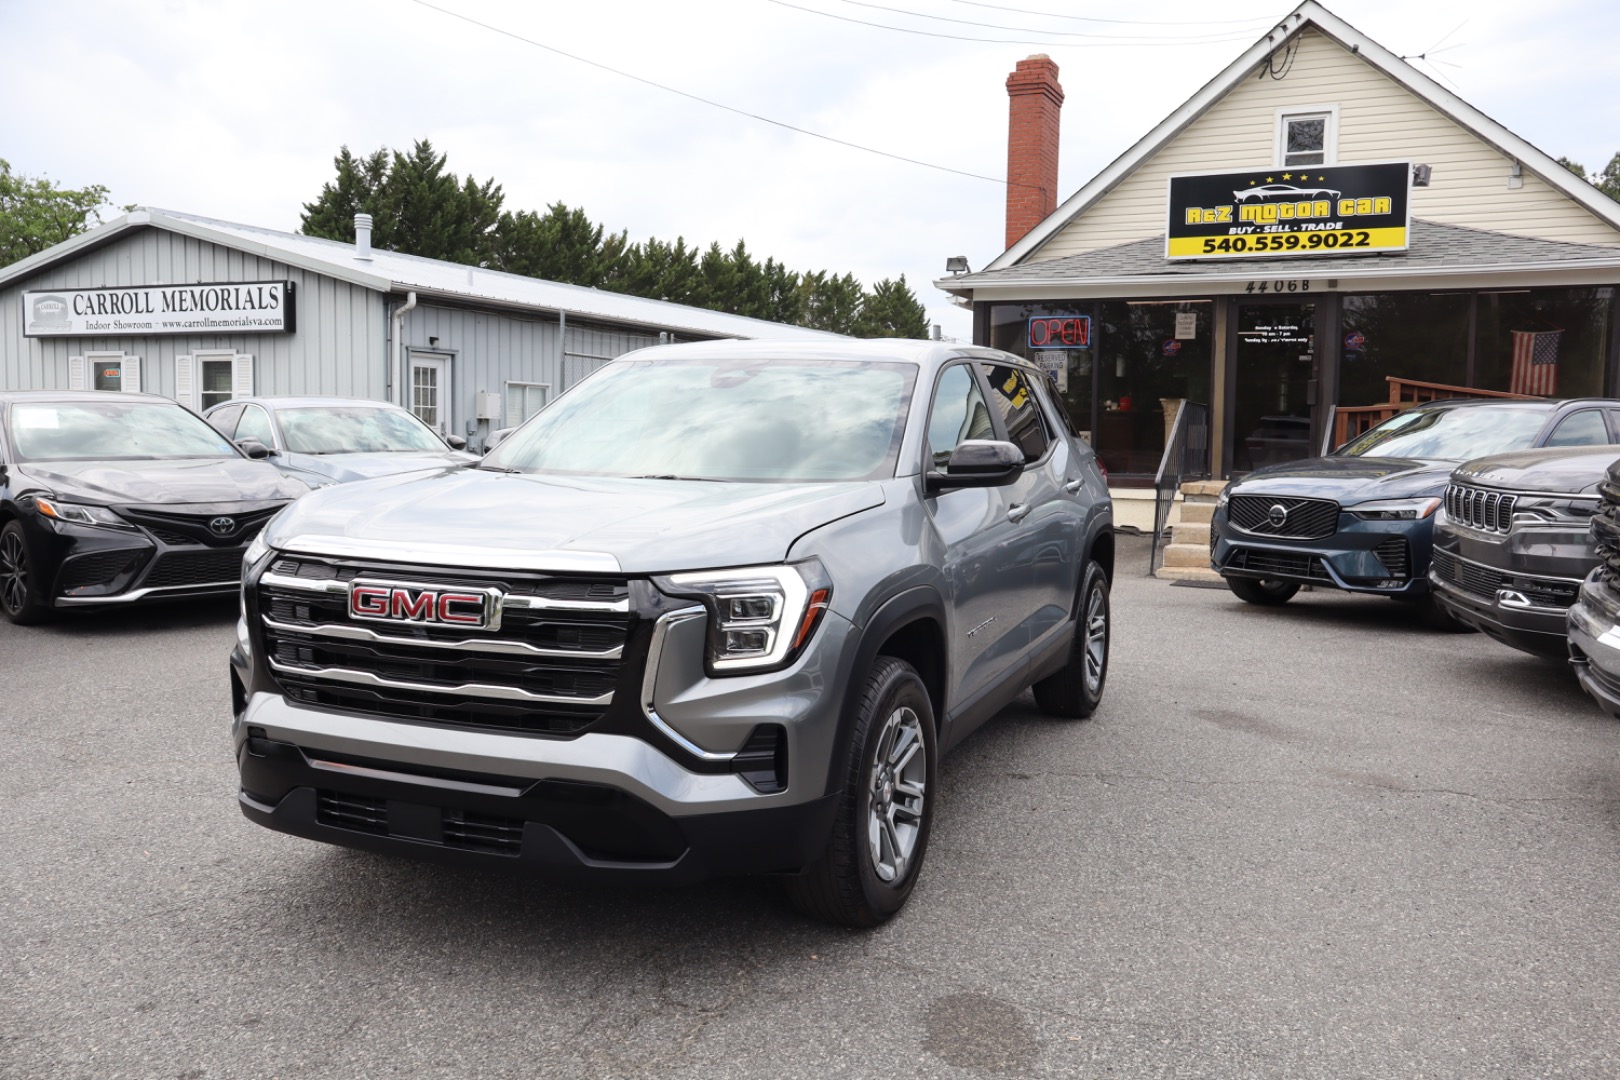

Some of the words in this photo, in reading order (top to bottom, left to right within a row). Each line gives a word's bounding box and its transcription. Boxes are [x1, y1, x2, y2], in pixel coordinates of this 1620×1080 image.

[1229, 226, 1255, 234] BUY
[1263, 225, 1291, 233] SELL
[1301, 222, 1343, 231] TRADE
[1203, 232, 1370, 253] 540.559.9022
[73, 292, 154, 315] CARROLL
[161, 286, 279, 312] MEMORIALS
[86, 320, 111, 330] Indoor
[113, 319, 152, 329] Showroom
[162, 316, 282, 328] www.carrollmemorialsva.com
[1031, 319, 1088, 345] OPEN
[1037, 354, 1066, 363] RESERVED
[1040, 361, 1063, 370] PARKING
[352, 586, 484, 625] GMC
